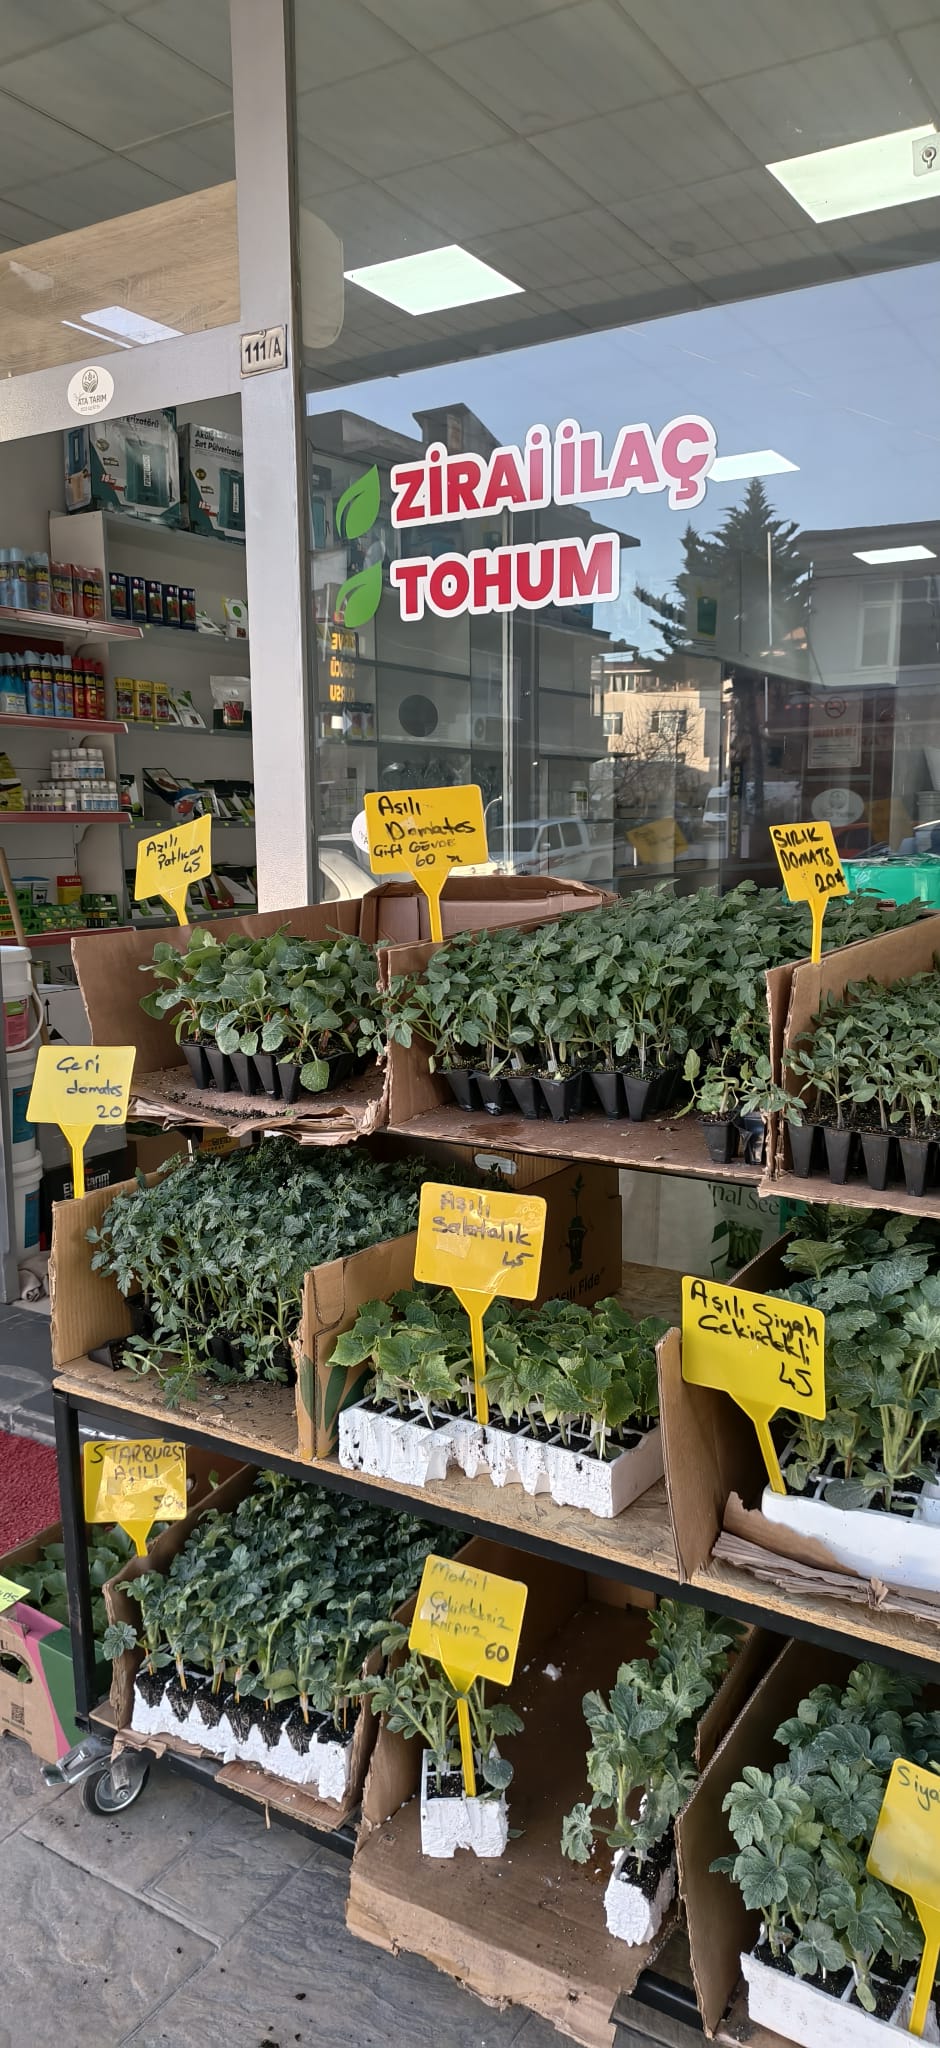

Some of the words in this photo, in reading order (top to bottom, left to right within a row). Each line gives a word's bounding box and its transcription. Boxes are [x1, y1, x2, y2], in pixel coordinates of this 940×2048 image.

[245, 336, 281, 364] 111/A
[77, 396, 89, 407] ATA
[89, 393, 107, 404] TARIM
[395, 431, 544, 522] ZİRAİ
[560, 422, 710, 501] İLAÇ
[395, 541, 613, 615] TOHUM
[377, 795, 422, 816] Aşılı
[183, 856, 202, 873] 45
[415, 853, 436, 868] 60
[96, 1104, 123, 1119] 20
[690, 1279, 745, 1318] Aşılı
[779, 1361, 813, 1397] 45
[90, 1443, 186, 1464] STARBURST
[484, 1642, 509, 1663] 60
